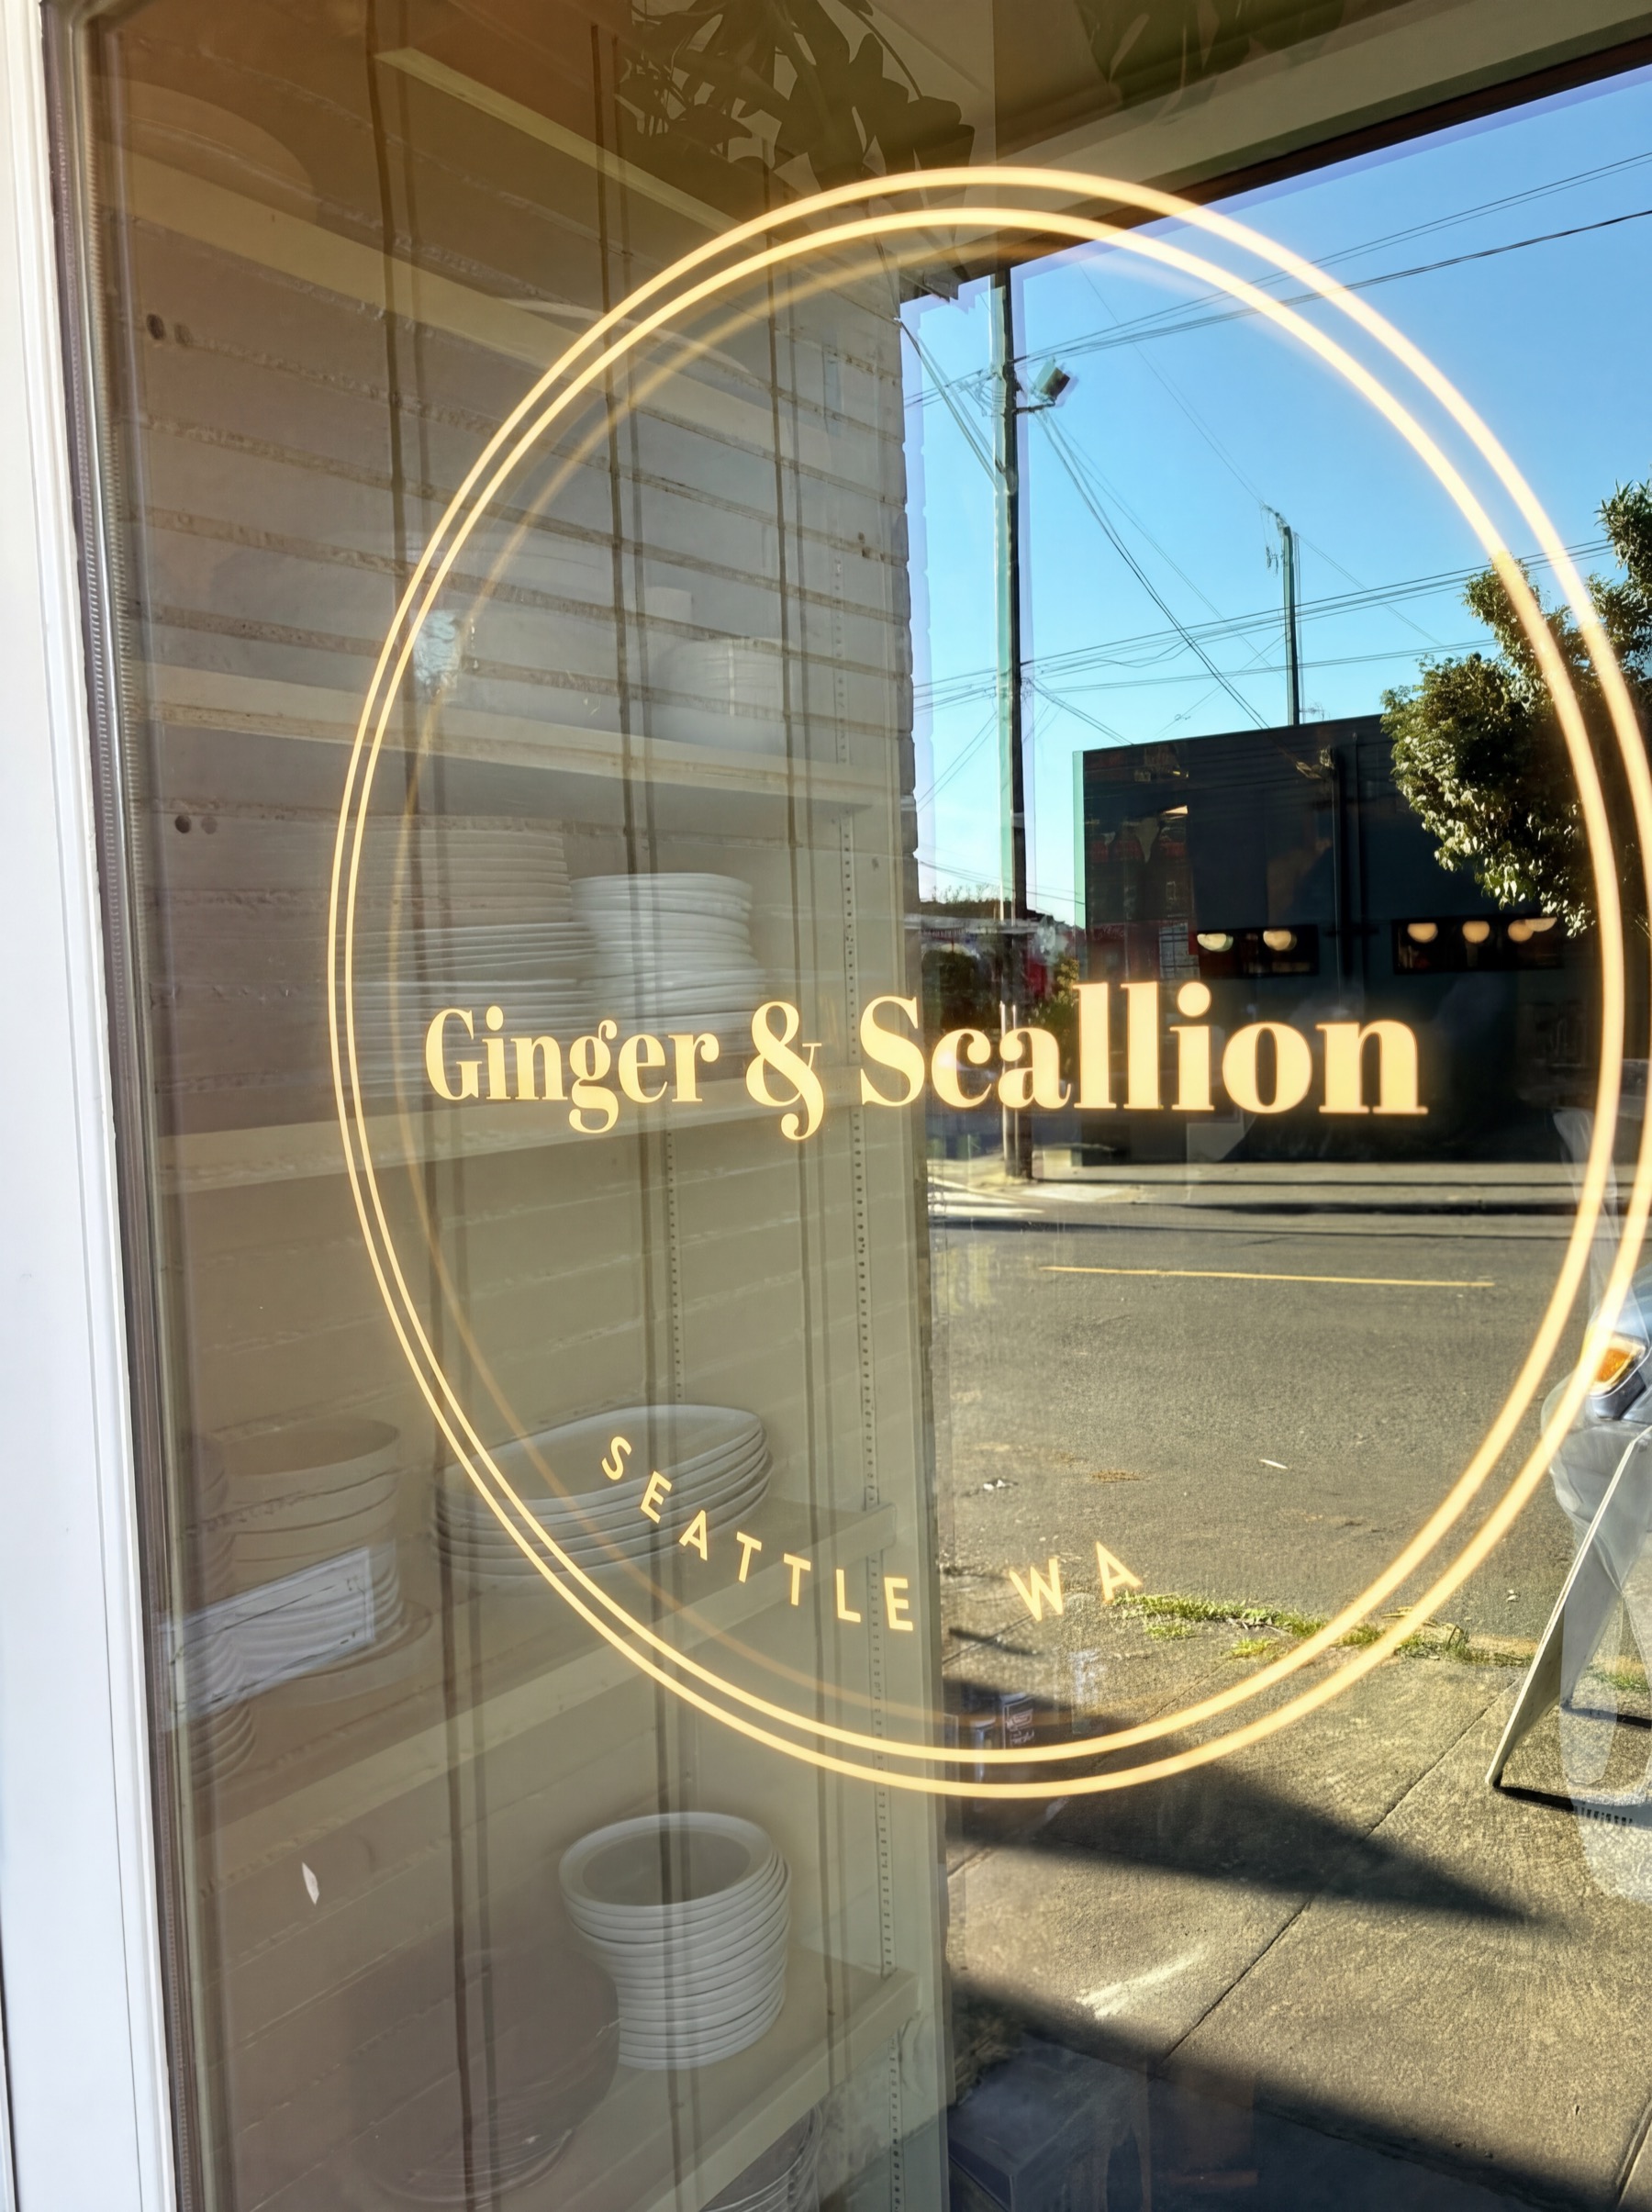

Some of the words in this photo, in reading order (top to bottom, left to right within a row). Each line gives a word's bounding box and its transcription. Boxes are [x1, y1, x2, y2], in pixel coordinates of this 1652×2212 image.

[424, 1005, 720, 1134] Ginger
[745, 1000, 824, 1141] &
[859, 981, 1428, 1114] Scallion
[601, 1436, 914, 1631] SEATTLE
[1010, 1541, 1143, 1621] WA
